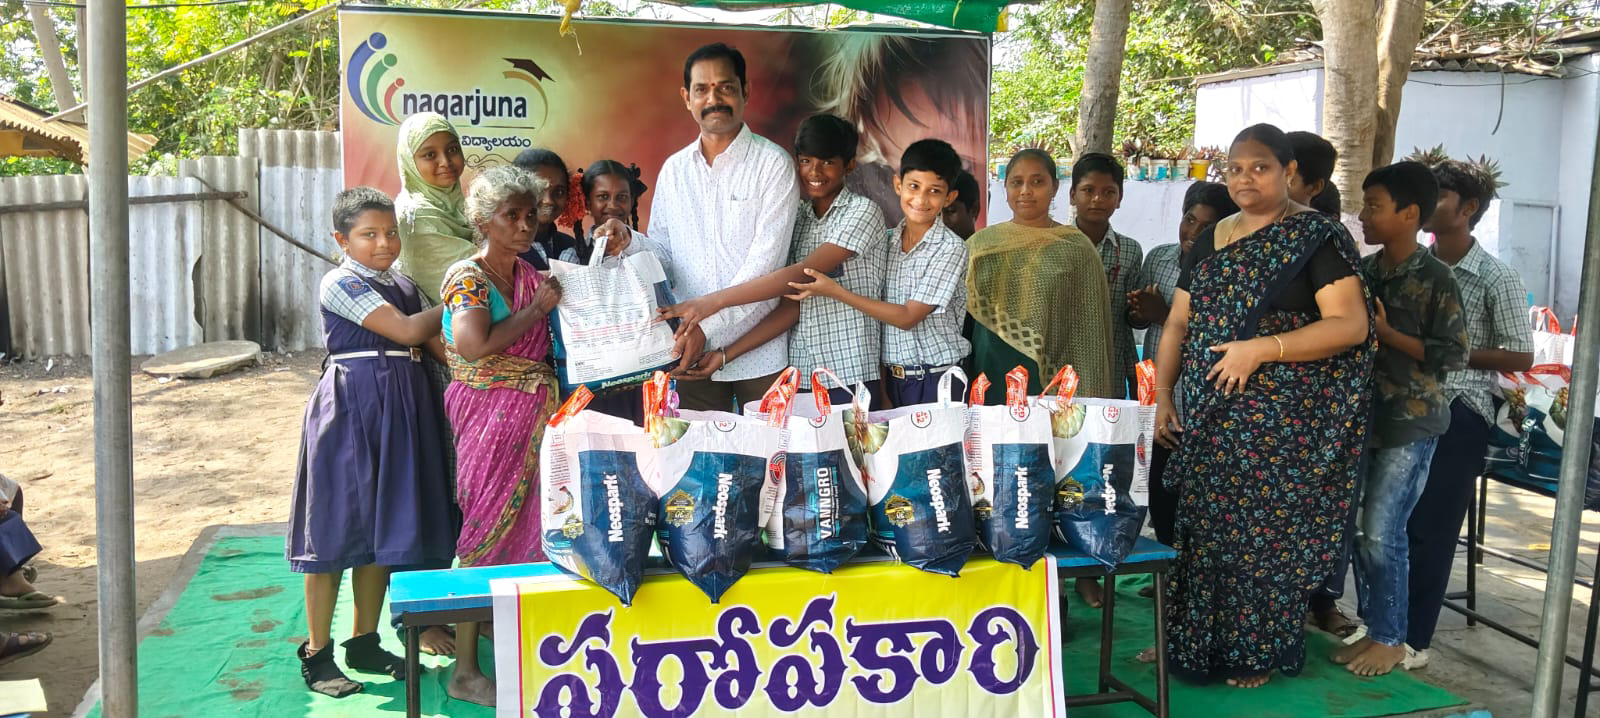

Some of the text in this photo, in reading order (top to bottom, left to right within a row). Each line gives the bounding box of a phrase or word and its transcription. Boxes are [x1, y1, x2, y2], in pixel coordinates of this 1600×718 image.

[403, 89, 528, 125] nagarjuna
[461, 135, 532, 152] విద్యాలయం
[603, 474, 625, 543] Neospark
[711, 472, 733, 540] Neospark
[815, 466, 831, 540] VANNGRO
[926, 468, 952, 534] Neospark
[1014, 466, 1030, 530] Neospark
[533, 594, 1041, 718] పరోపకారి
